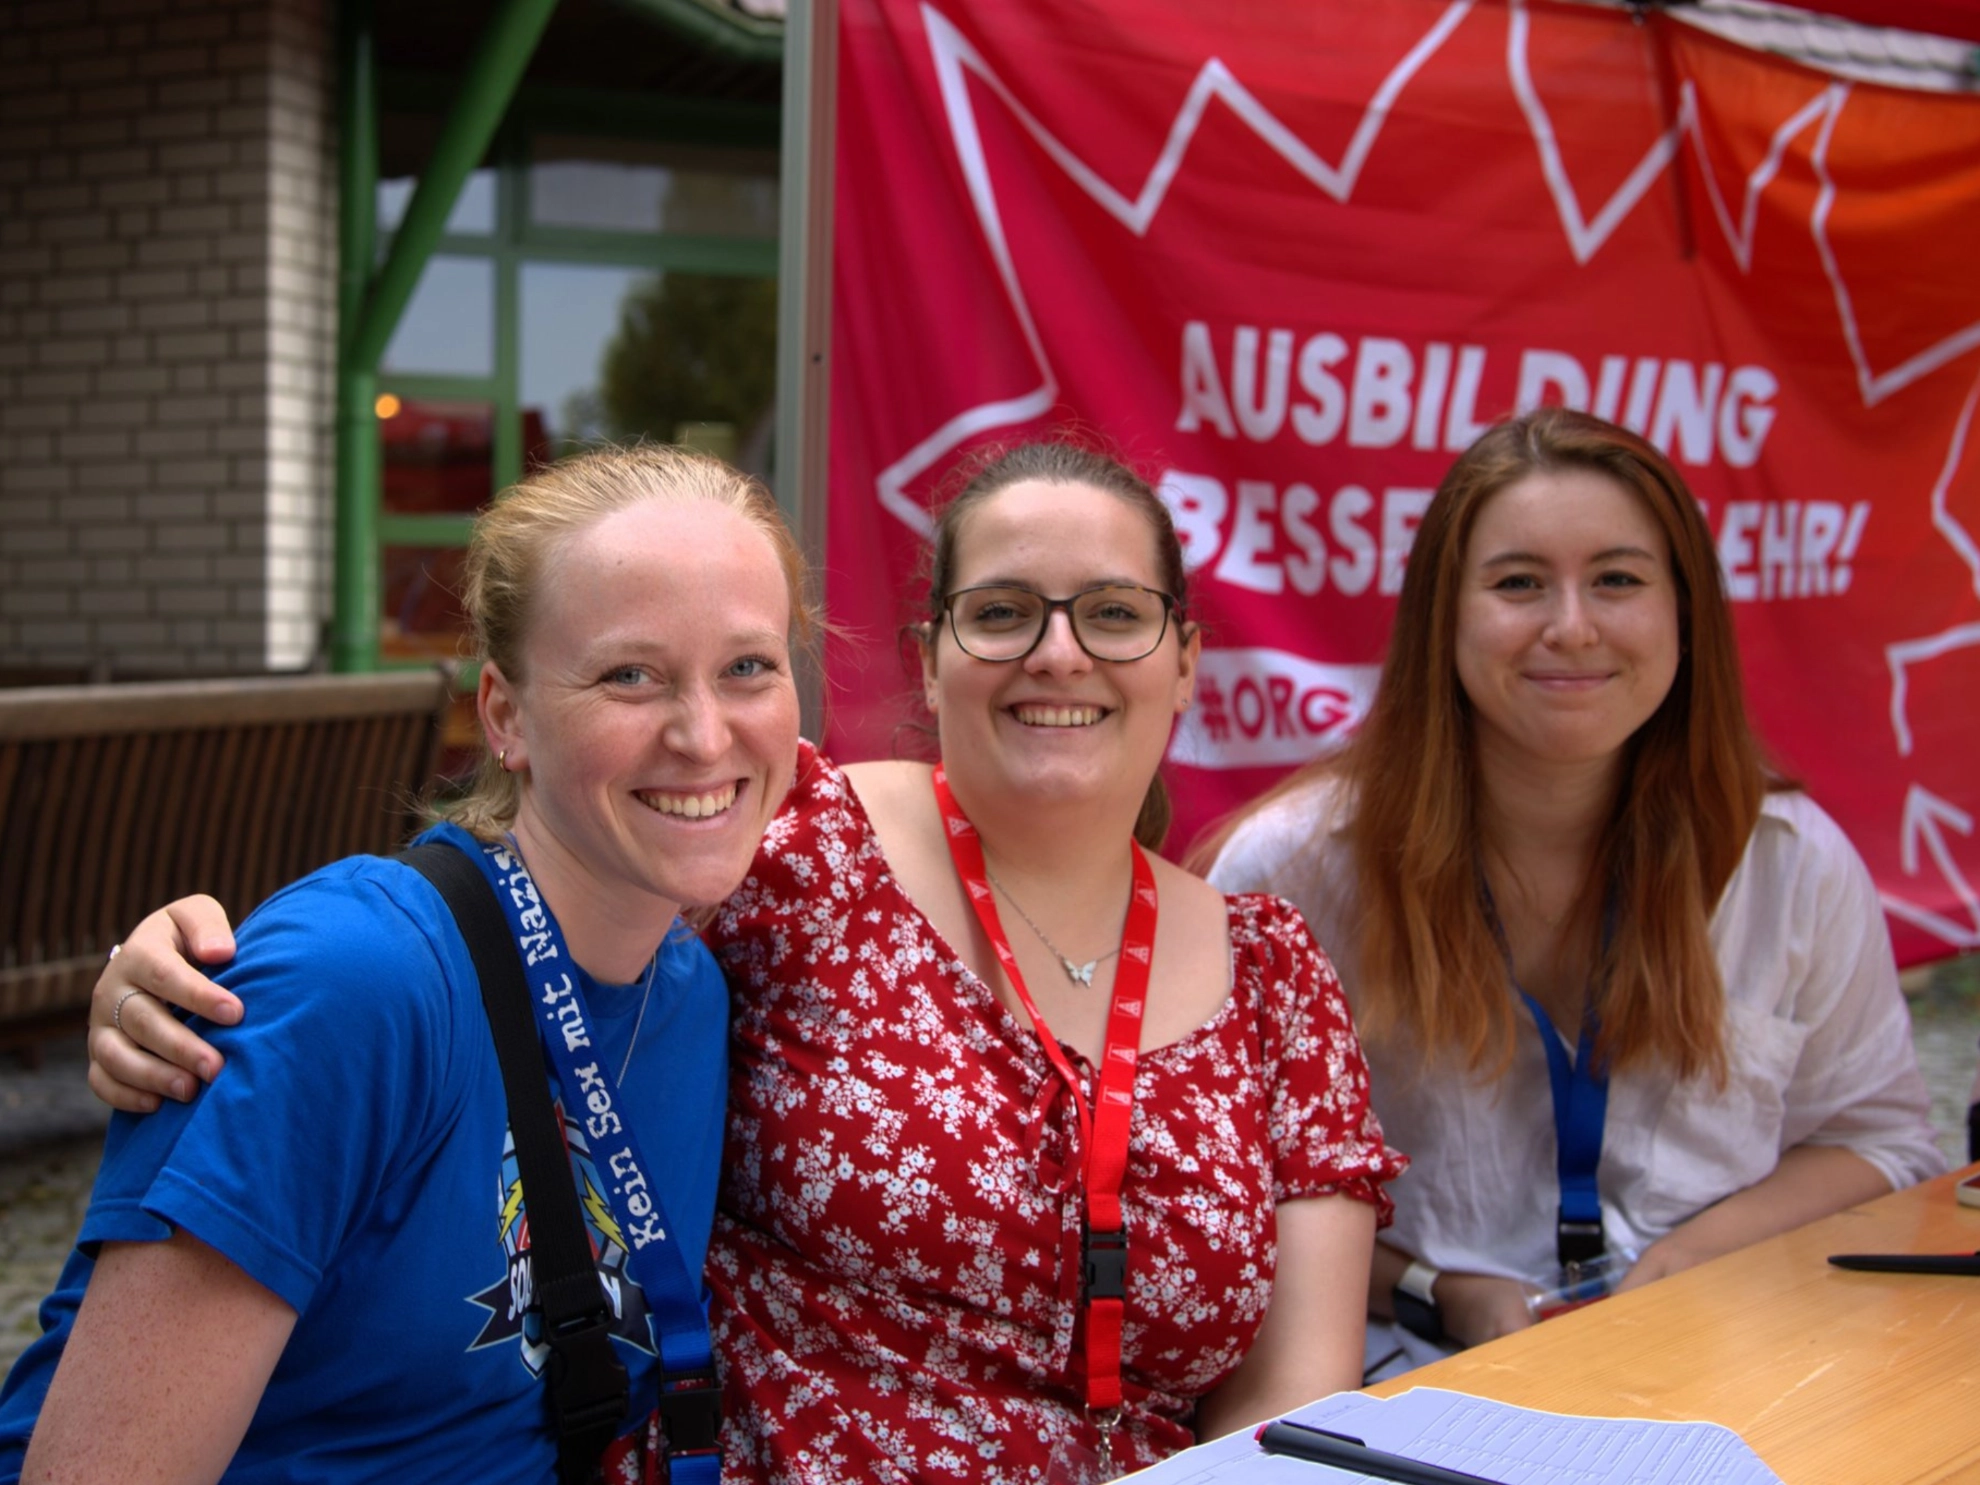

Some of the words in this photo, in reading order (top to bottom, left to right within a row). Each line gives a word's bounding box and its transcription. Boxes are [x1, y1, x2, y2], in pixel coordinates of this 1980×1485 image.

[1176, 320, 1778, 469] AUSBILDUNG
[1157, 468, 1438, 597] BESSE
[1696, 498, 1872, 602] EHR!
[1196, 674, 1360, 742] #ORG
[541, 973, 591, 1052] mit
[574, 1061, 623, 1140] Sex
[609, 1146, 667, 1250] Kein
